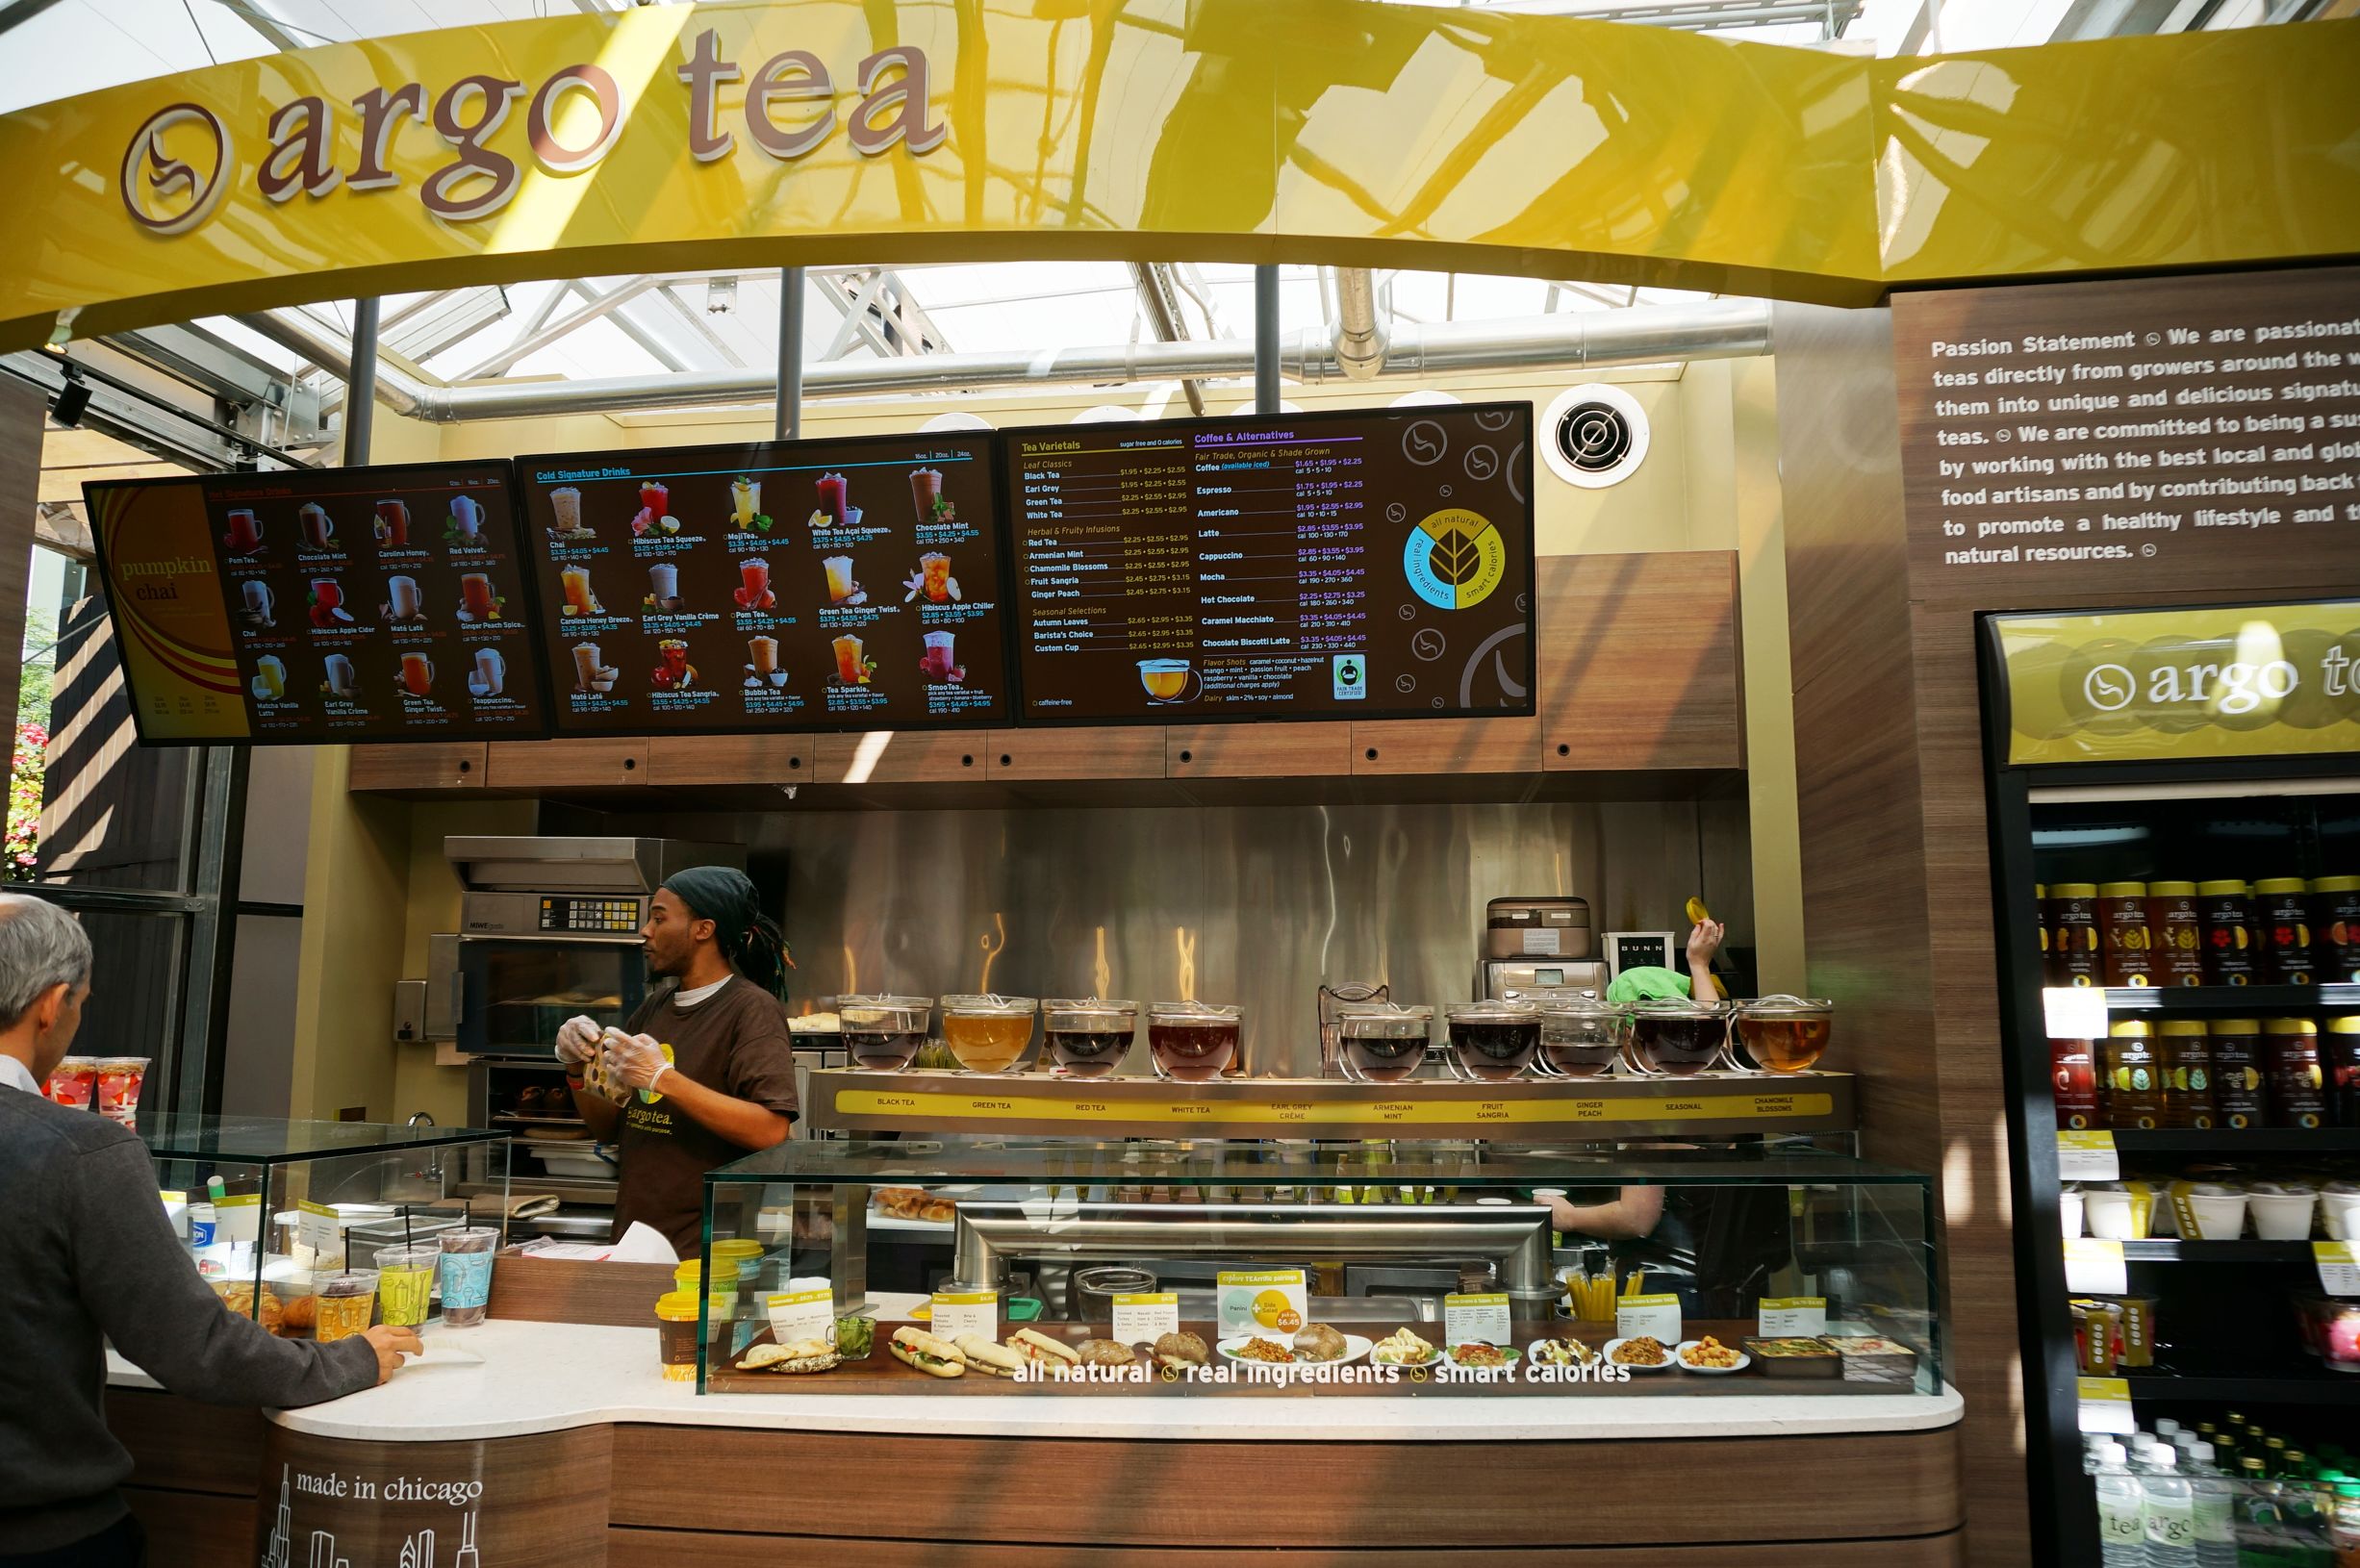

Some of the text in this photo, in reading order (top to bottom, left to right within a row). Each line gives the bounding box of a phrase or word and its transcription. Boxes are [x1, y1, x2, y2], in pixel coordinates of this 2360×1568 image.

[257, 27, 948, 221] argo tea
[1932, 339, 2013, 357] Passion
[2022, 331, 2136, 353] Statement
[2167, 328, 2200, 345] We
[2209, 327, 2246, 343] are
[1932, 370, 1979, 387] teas
[1985, 366, 2066, 385] directly
[2071, 364, 2123, 380] from
[2128, 360, 2216, 380] growers
[2220, 352, 2297, 372] around
[2302, 351, 2342, 368] the
[1935, 400, 1991, 417] them
[1997, 396, 2040, 414] into
[2047, 393, 2119, 413] unique
[2127, 390, 2168, 407] and
[2175, 386, 2273, 405] delicious
[1937, 430, 1990, 446] teas.
[2017, 425, 2049, 443] We
[2054, 426, 2089, 441] are
[2094, 418, 2211, 438] committed
[2216, 417, 2241, 434] to
[2244, 414, 2305, 434] being
[2310, 415, 2324, 429] a
[1195, 431, 1294, 443] Coffee & Alternatives
[1022, 442, 1080, 452] Tea Varietals
[1238, 450, 1267, 460] Organic
[1279, 448, 1302, 457] Shade
[1024, 461, 1040, 469] Leaf
[1939, 460, 1965, 479] by
[1971, 457, 2054, 475] working
[2061, 453, 2109, 470] with
[2115, 451, 2152, 468] the
[2157, 448, 2207, 467] best
[2213, 445, 2266, 465] local
[2271, 443, 2314, 462] and
[1195, 464, 1220, 472] Coffee
[536, 468, 631, 481] Cold Signature Drinks
[1042, 485, 1059, 493] Grey
[1197, 487, 1231, 495] Espresso
[1941, 489, 1987, 506] food
[1992, 486, 2080, 504] artisans
[2085, 483, 2124, 500] and
[2128, 482, 2155, 501] by
[2160, 476, 2297, 497] contributing
[2299, 472, 2354, 493] back
[1198, 509, 1239, 518] Americano
[916, 521, 969, 532] Chocolate Mint
[1432, 516, 1479, 528] all natural
[1943, 520, 1966, 536] to
[1978, 516, 2065, 539] promote
[2076, 518, 2091, 532] a
[2102, 511, 2182, 531] healthy
[2194, 507, 2281, 529] lifestyle
[2293, 504, 2334, 523] and
[1061, 526, 1083, 535] Fruity
[1085, 524, 1120, 534] Infusions
[1029, 551, 1065, 560] Armenian
[1200, 552, 1243, 562] Cappuccino
[1945, 544, 2134, 565] natural resources.
[121, 556, 212, 580] pumpkin
[1073, 563, 1108, 571] Blossoms
[1413, 539, 1449, 600] real ingredients
[1466, 541, 1497, 597] smart calories
[1051, 577, 1078, 586] Sangria
[137, 582, 178, 600] chai
[1031, 591, 1055, 599] Ginger
[1217, 594, 1255, 604] Chocolate
[952, 602, 971, 612] Apple
[973, 601, 994, 610] Chiller
[1033, 619, 1061, 627] Autumn
[1234, 616, 1274, 624] Macchiato
[1065, 644, 1079, 652] Cup
[1203, 637, 1290, 647] Chocolate Biscotti Latte
[768, 688, 781, 696] Tea
[2147, 660, 2299, 715] argo
[1013, 1362, 1631, 1389] all natural real ingredients smart calories
[296, 1473, 483, 1505] made in chicago
[2111, 1516, 2140, 1535] tea
